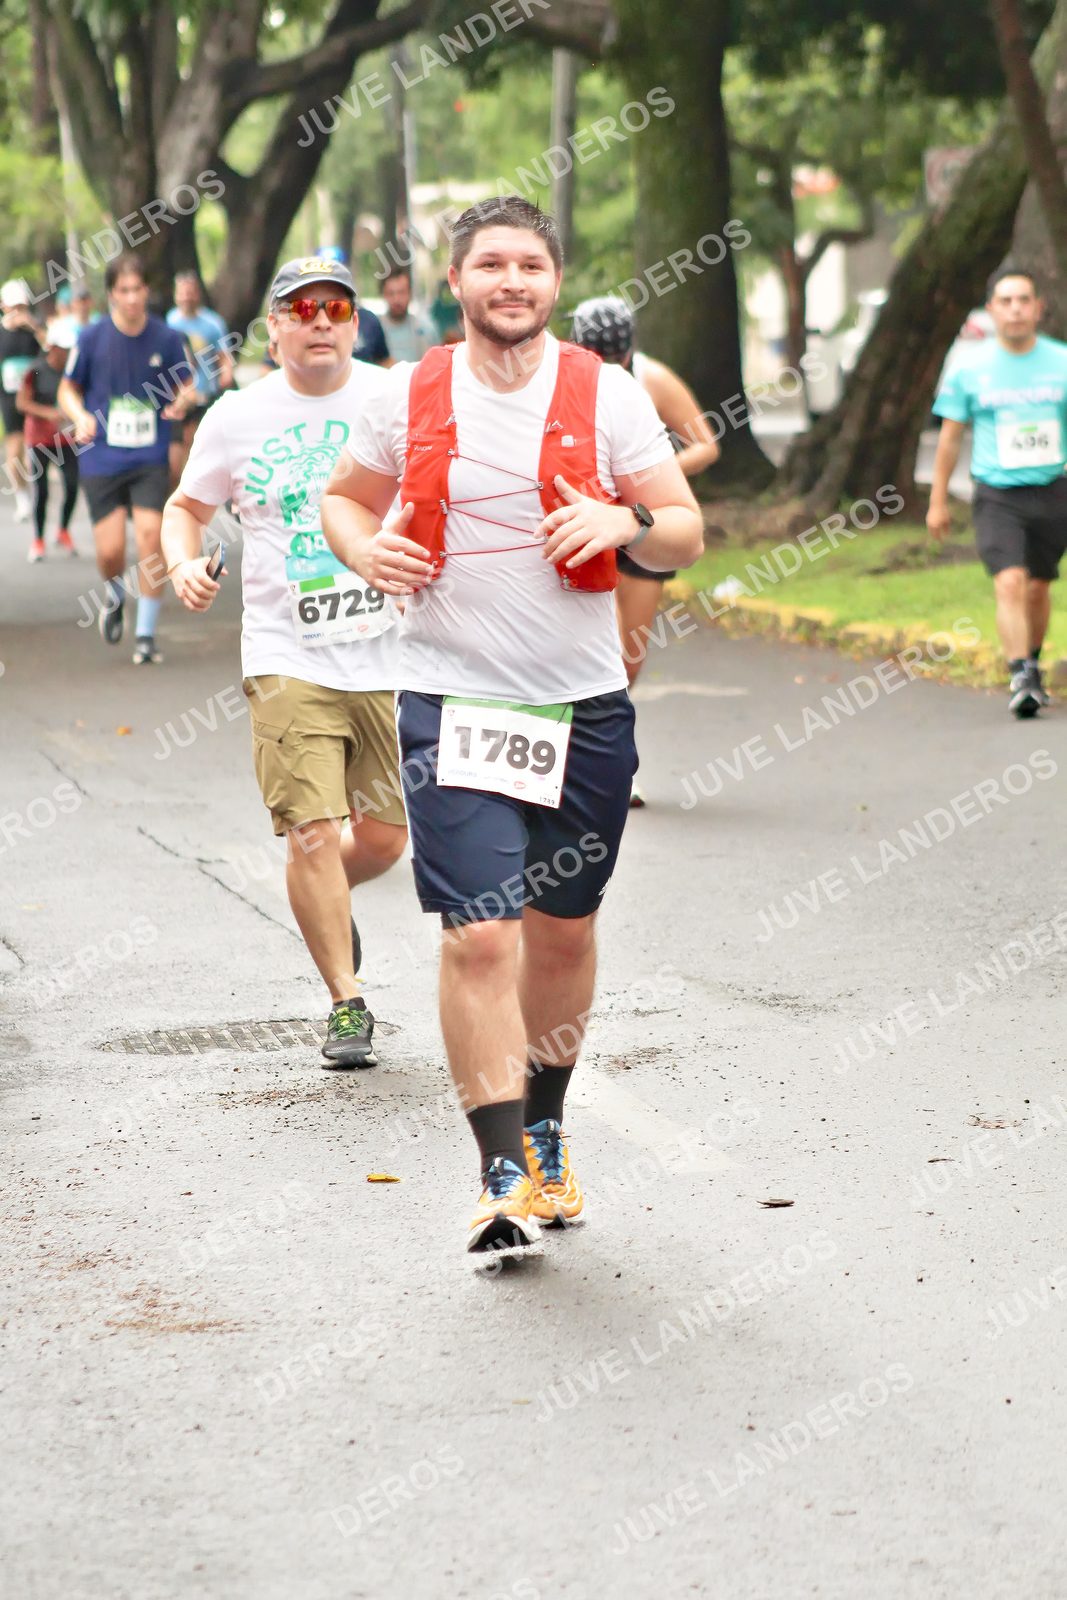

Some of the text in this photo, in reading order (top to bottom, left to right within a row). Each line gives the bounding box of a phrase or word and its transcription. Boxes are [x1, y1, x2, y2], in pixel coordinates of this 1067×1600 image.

[244, 422, 307, 506] JUST
[323, 419, 350, 445] D
[298, 586, 385, 624] 6729
[454, 725, 556, 775] 1789
